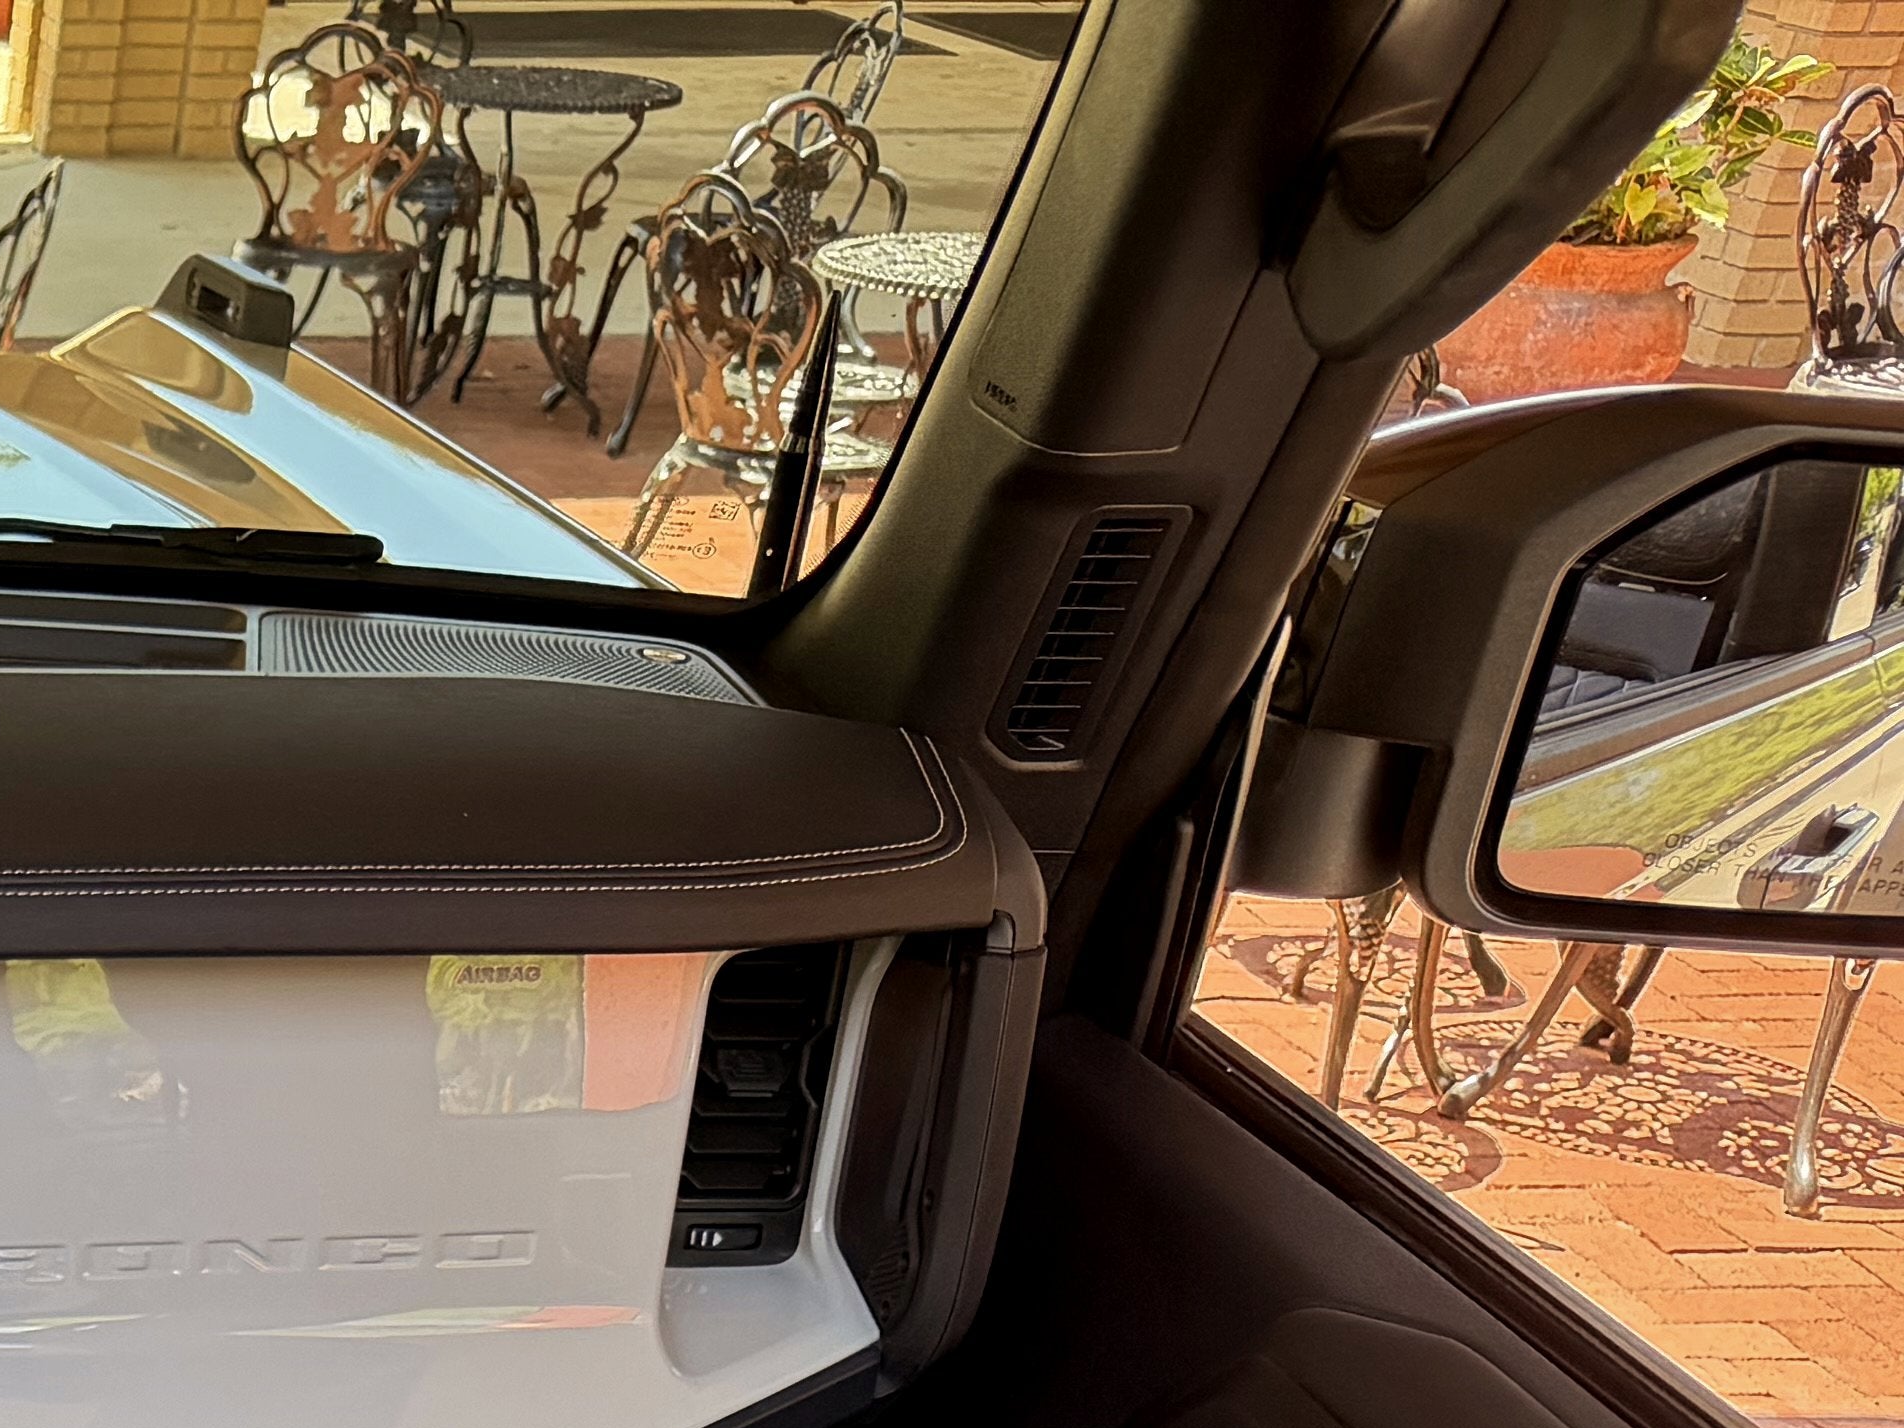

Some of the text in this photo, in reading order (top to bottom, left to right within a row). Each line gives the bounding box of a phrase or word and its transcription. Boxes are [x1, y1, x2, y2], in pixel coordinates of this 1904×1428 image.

[1664, 833, 1757, 858] OBJECTS
[1642, 852, 1721, 875] CLOSER
[457, 966, 541, 984] AIRBAG
